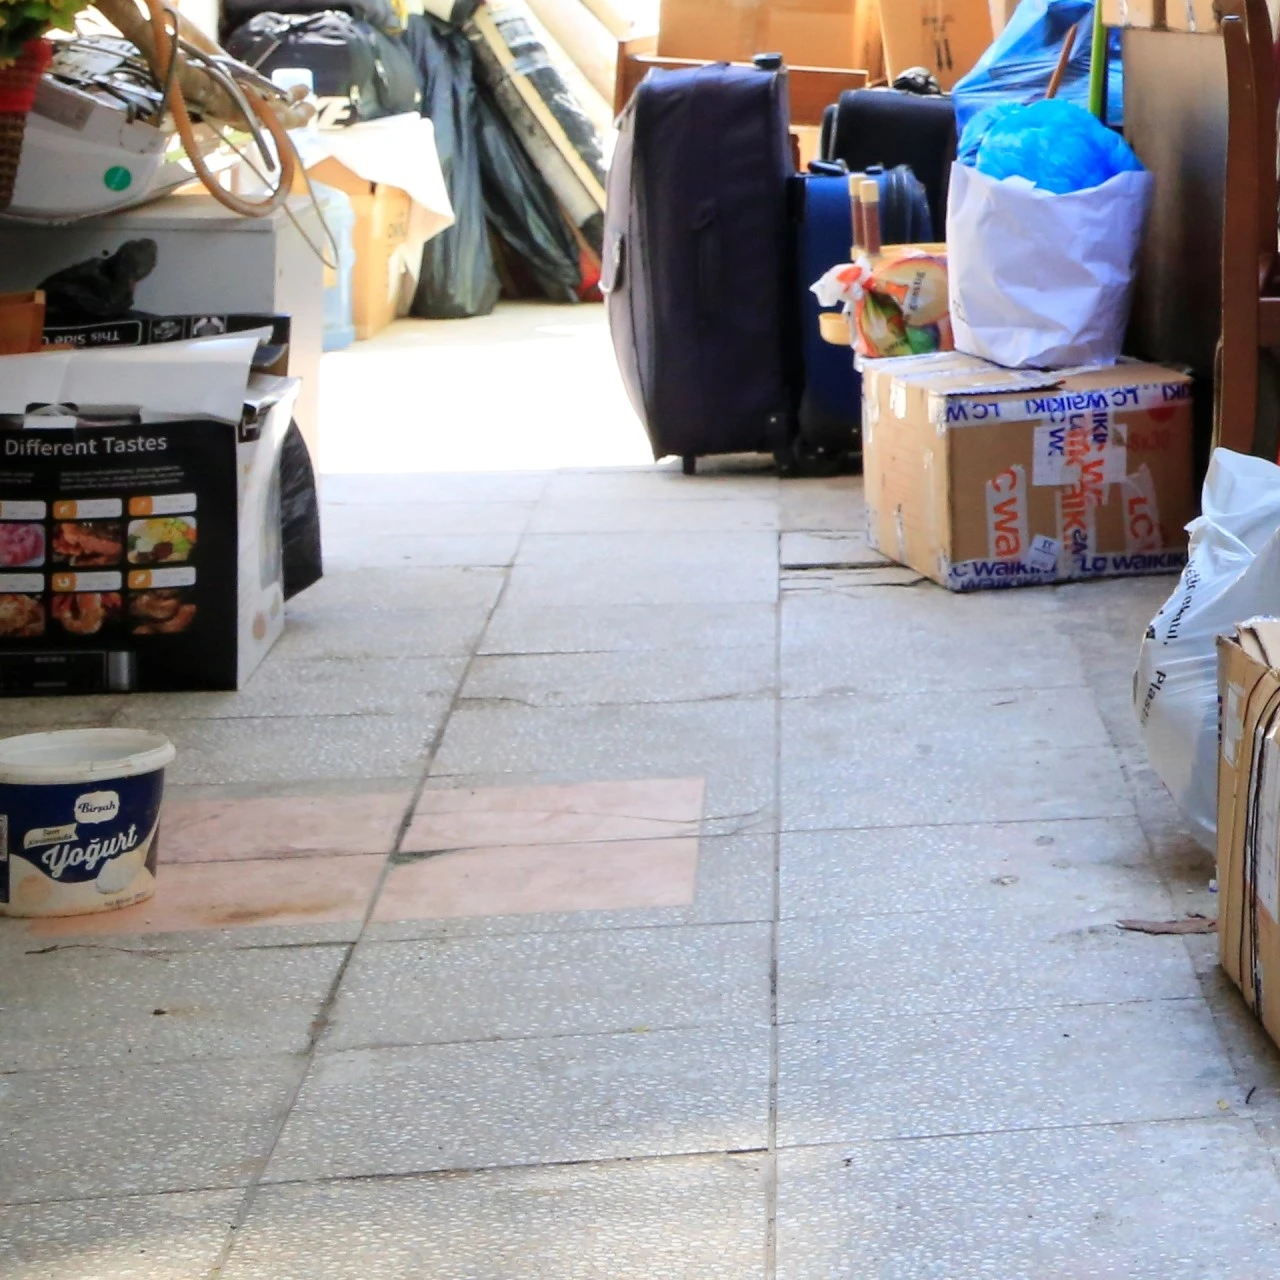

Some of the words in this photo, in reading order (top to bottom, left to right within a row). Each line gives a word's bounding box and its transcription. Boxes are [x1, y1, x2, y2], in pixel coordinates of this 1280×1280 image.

[972, 401, 1000, 420] LC
[5, 438, 97, 457] Different
[102, 435, 168, 454] Tastes
[41, 823, 138, 878] Yoğurt
